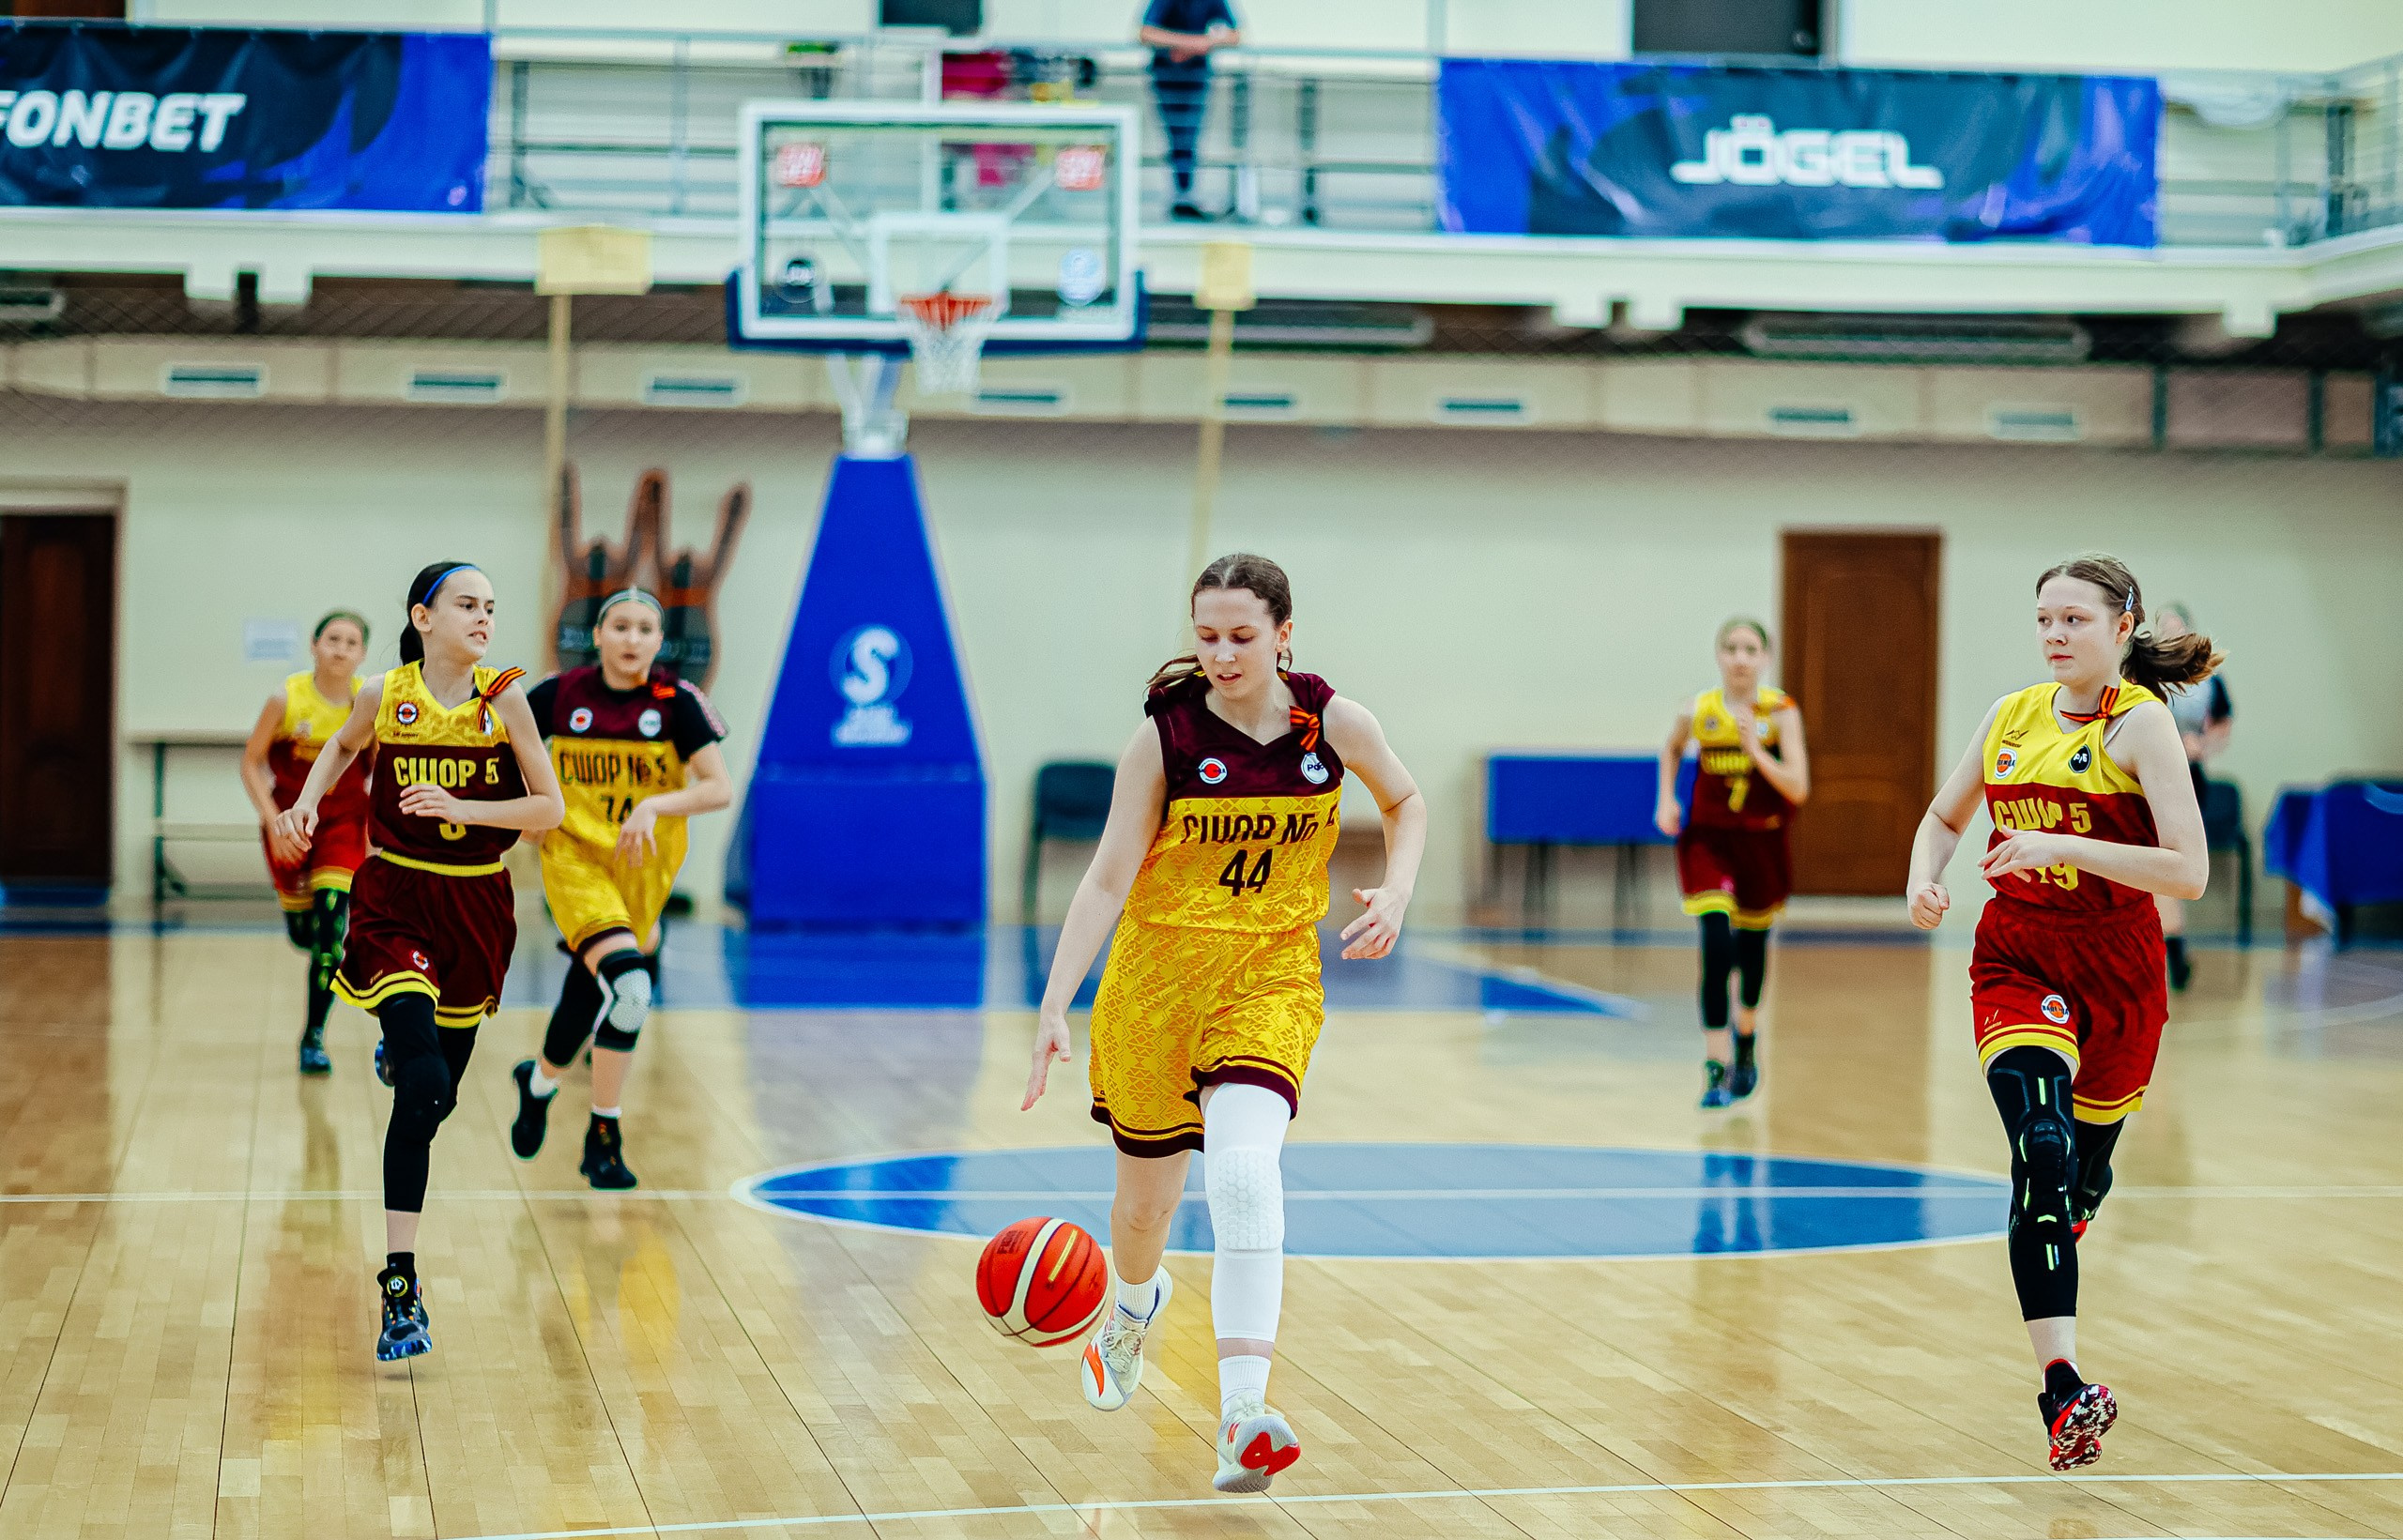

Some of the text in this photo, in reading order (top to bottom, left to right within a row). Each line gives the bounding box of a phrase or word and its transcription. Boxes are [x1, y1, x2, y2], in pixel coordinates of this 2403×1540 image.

[1669, 113, 1945, 190] JÖGEL
[393, 756, 499, 788] СШОР 5
[1993, 797, 2092, 833] СШОР 5
[1218, 848, 1273, 897] 44
